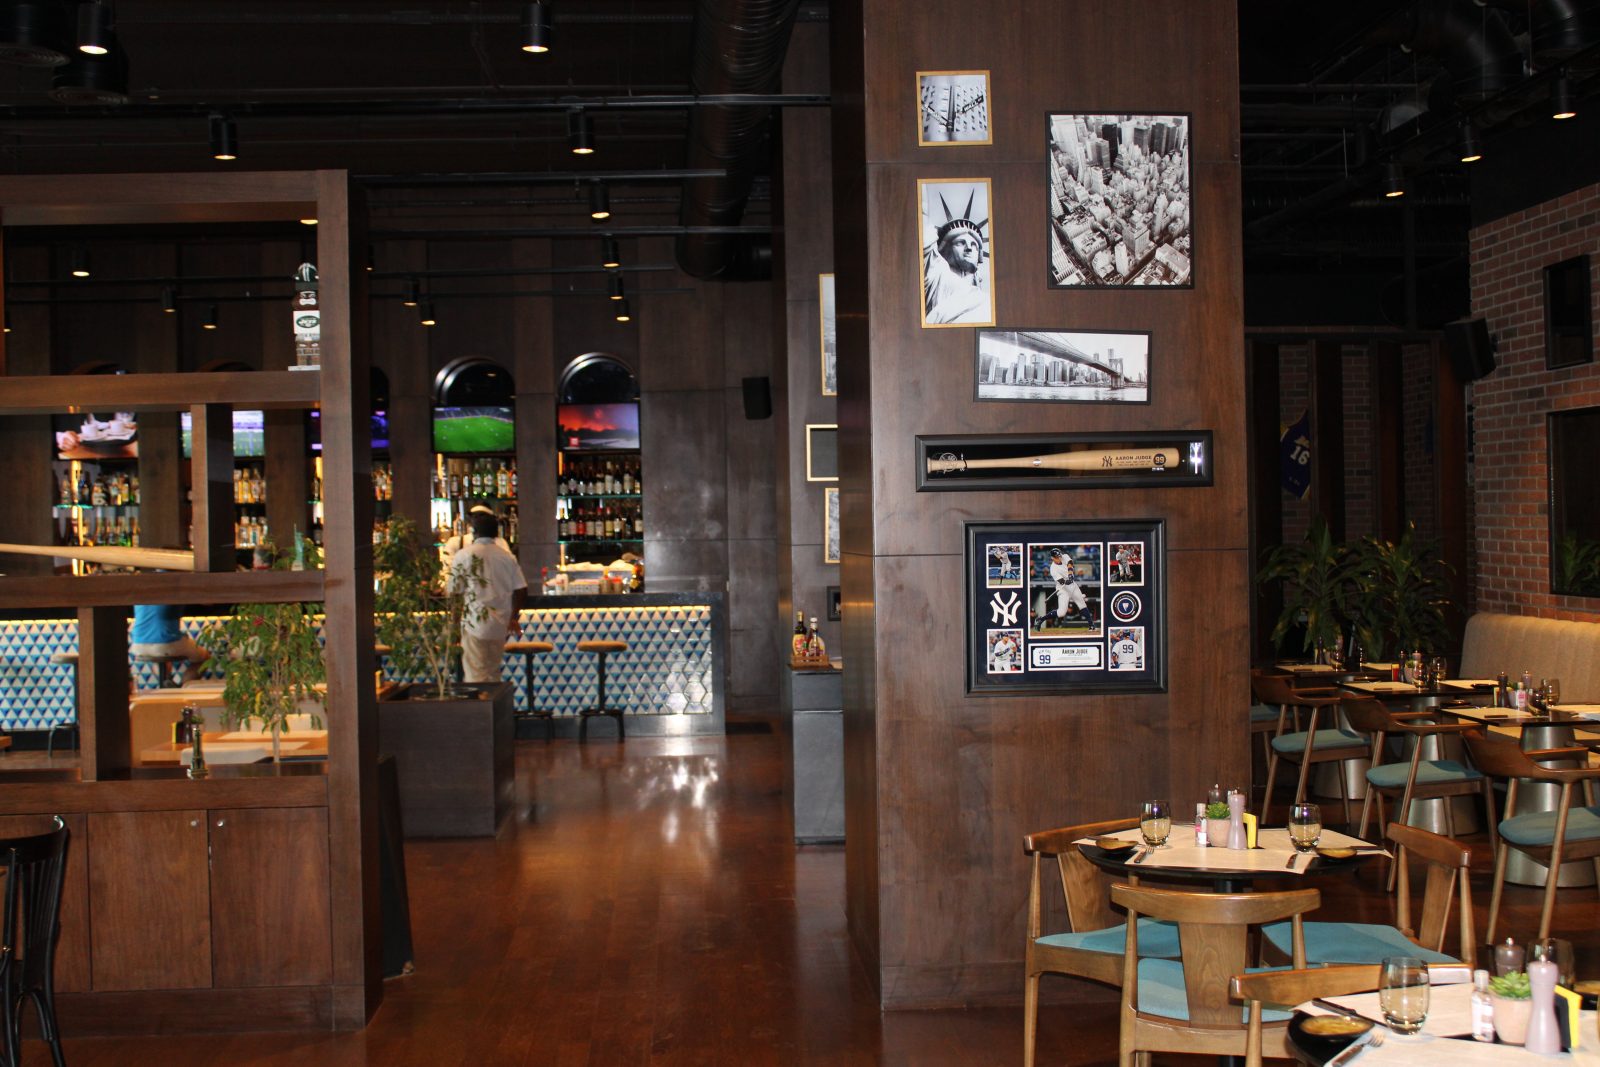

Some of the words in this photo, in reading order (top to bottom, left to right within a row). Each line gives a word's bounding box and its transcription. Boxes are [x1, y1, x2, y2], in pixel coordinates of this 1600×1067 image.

[1155, 456, 1165, 464] 99
[990, 591, 1022, 626] NY
[1122, 644, 1134, 653] 99
[1039, 655, 1051, 664] 99
